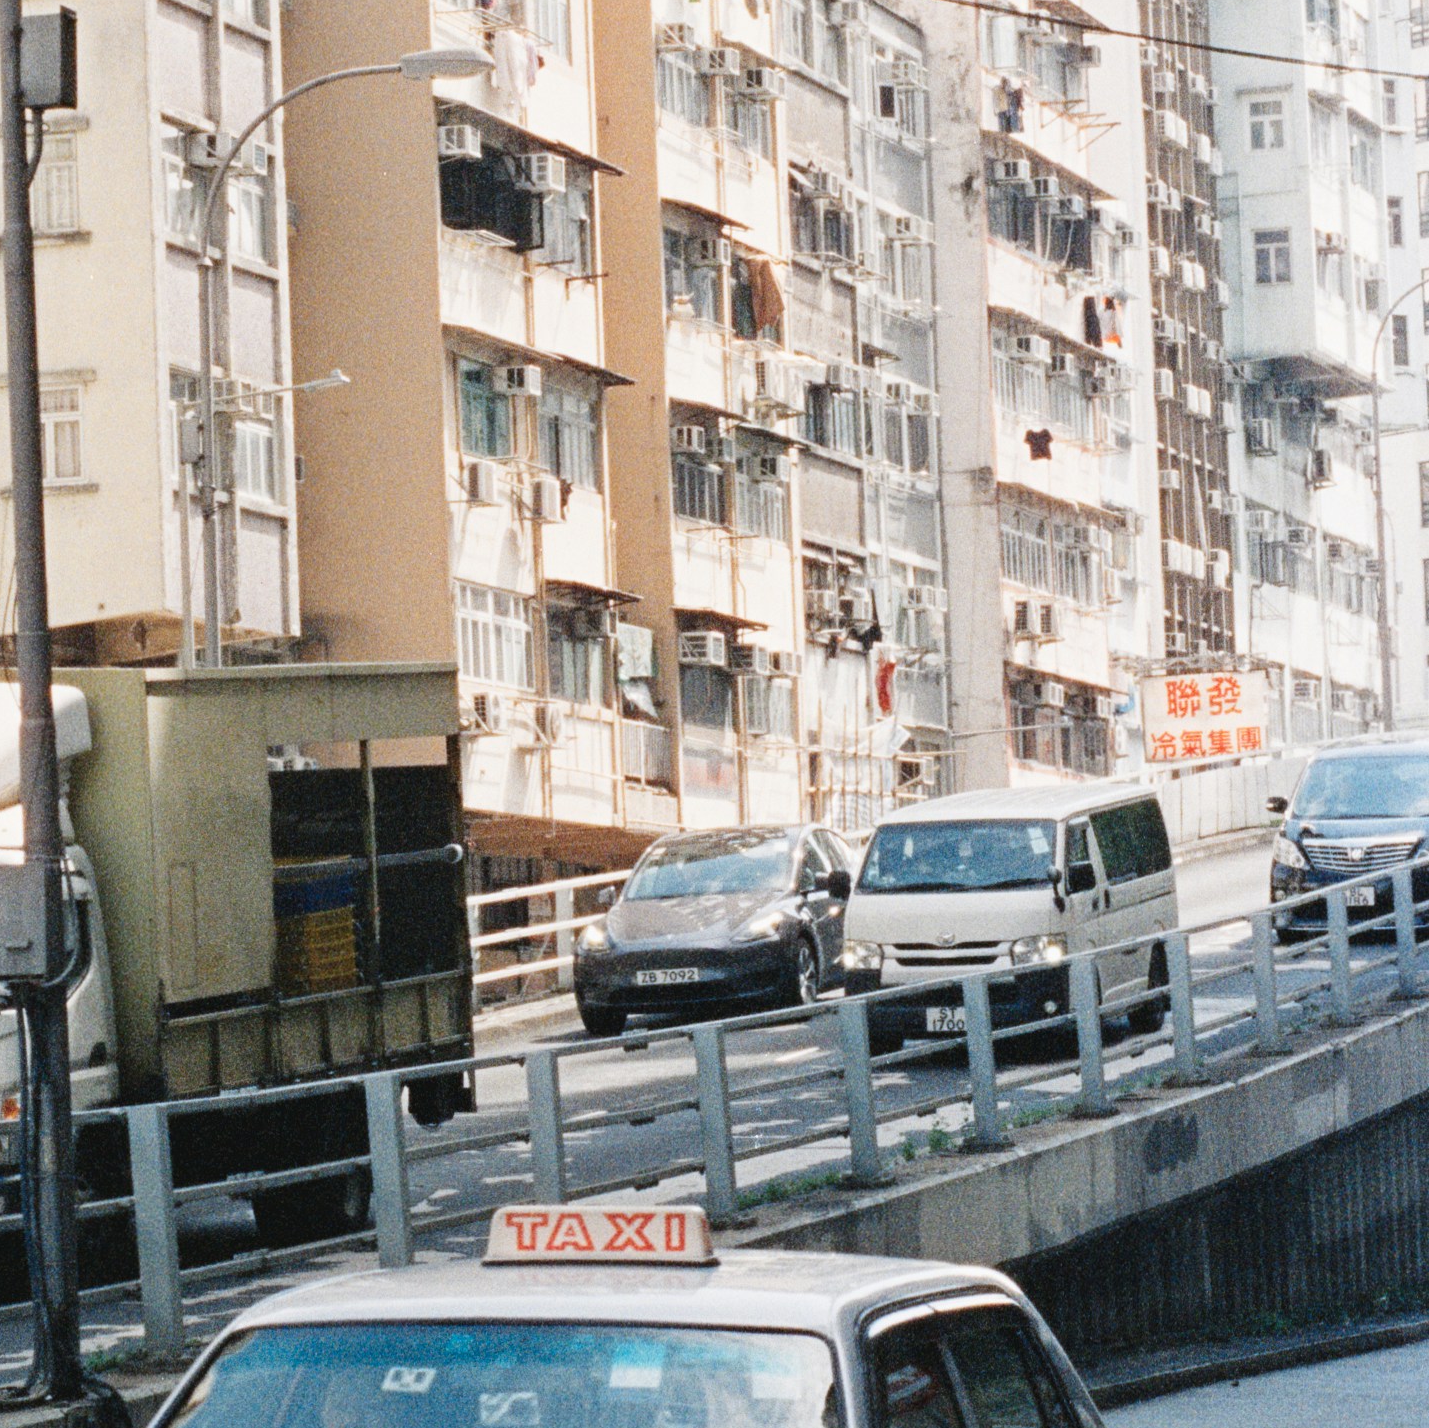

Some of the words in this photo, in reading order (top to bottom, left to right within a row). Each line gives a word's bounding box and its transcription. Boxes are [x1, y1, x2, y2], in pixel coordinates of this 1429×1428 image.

[1166, 676, 1242, 718] 聯發
[1150, 726, 1262, 759] 冷氣集團
[641, 972, 657, 984] ZB
[661, 969, 696, 982] 7092
[932, 1018, 965, 1031] 1700
[505, 1211, 687, 1252] TAXI
